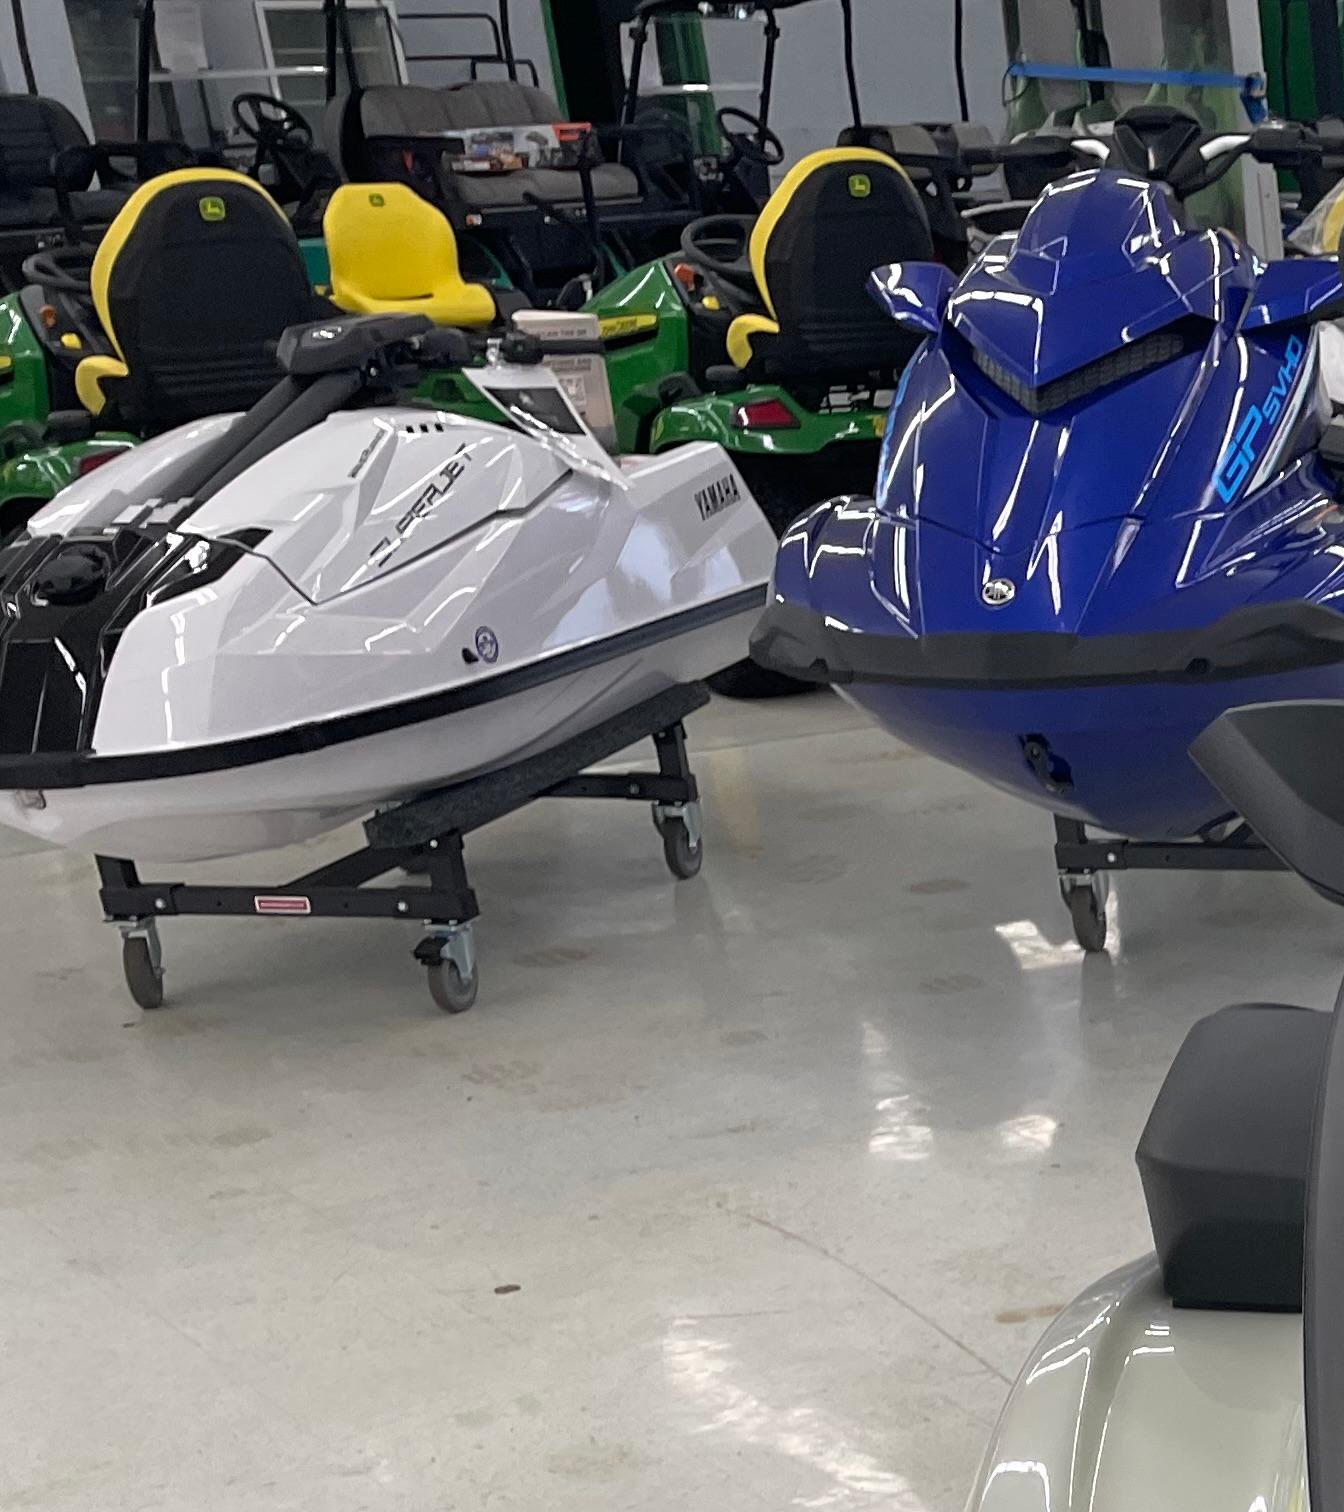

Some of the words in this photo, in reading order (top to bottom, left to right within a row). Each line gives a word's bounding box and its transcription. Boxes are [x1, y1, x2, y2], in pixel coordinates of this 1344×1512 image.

[1212, 404, 1263, 503] GP
[1262, 334, 1303, 425] SVHO
[694, 472, 741, 521] YAMAHA
